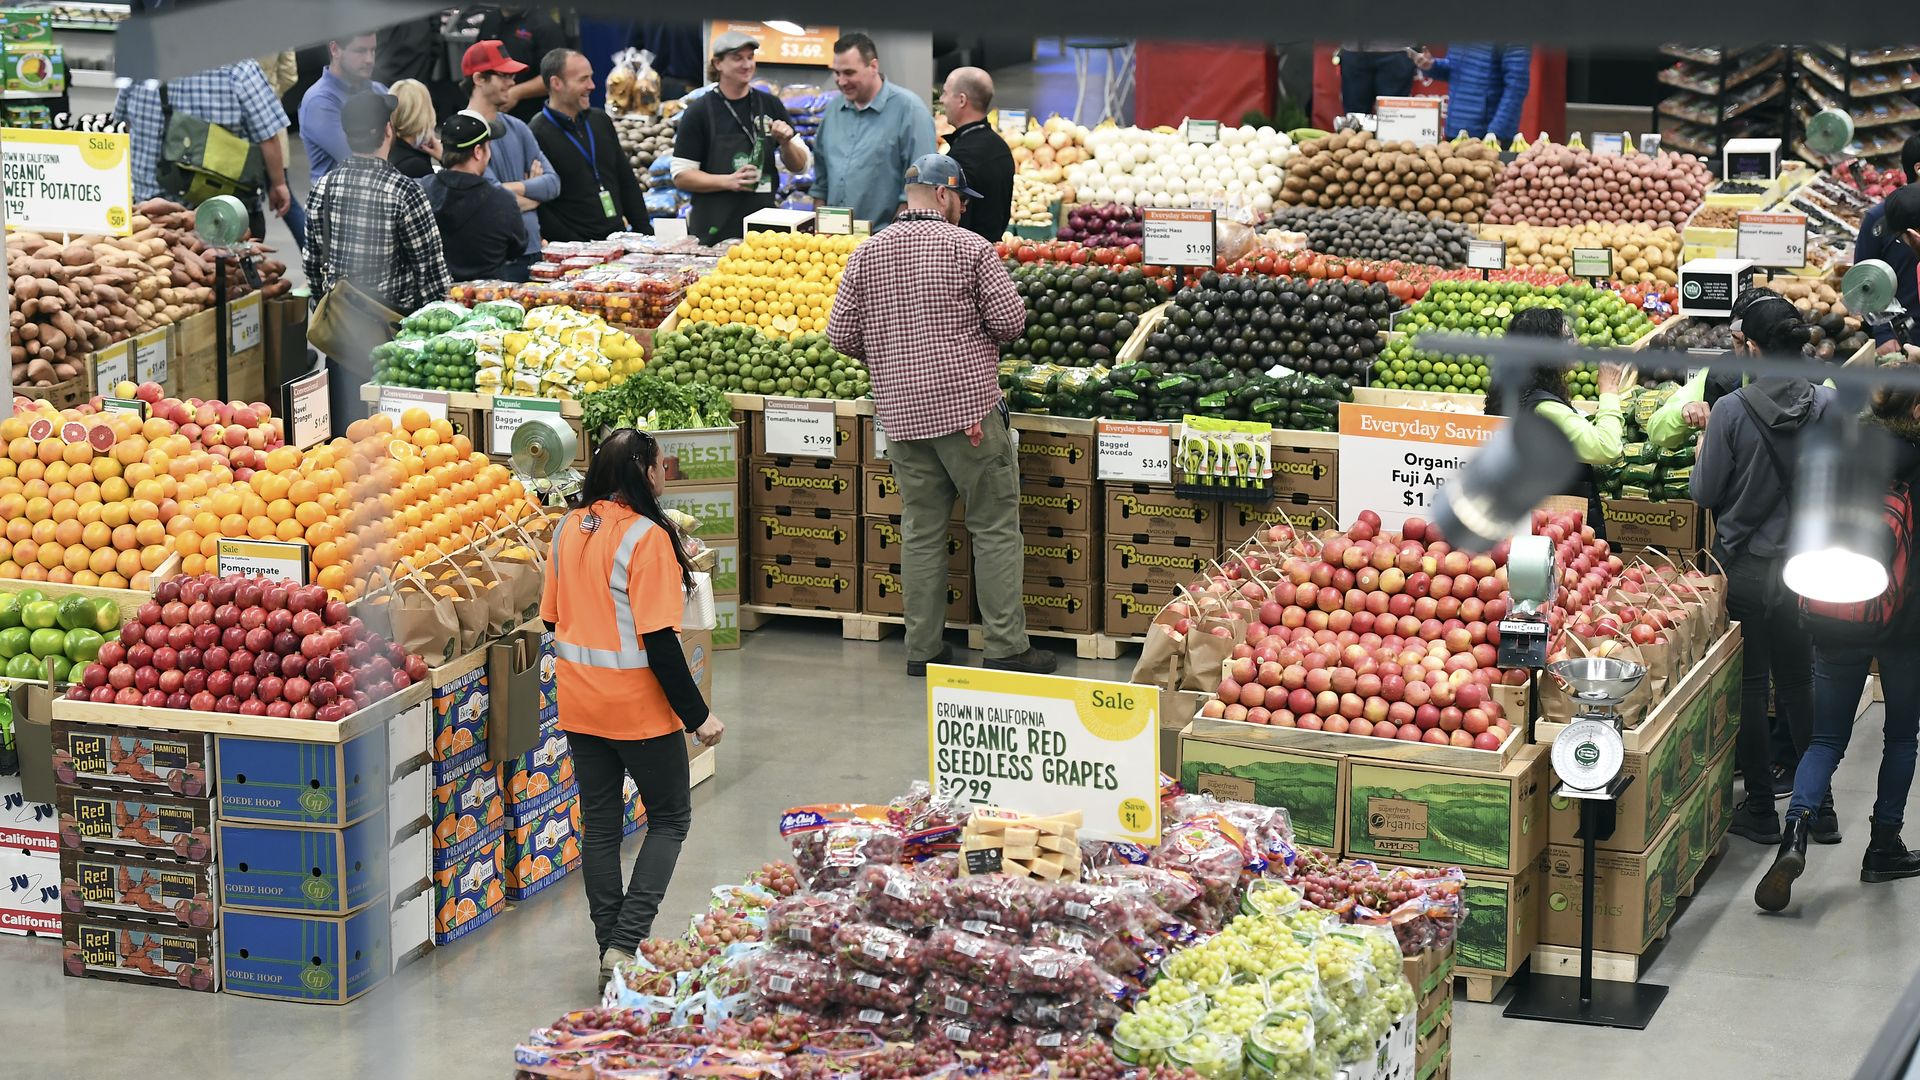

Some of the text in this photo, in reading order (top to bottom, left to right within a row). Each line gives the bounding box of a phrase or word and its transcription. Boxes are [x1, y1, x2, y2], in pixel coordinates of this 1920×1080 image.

[89, 138, 115, 150] Sale
[3, 152, 60, 163] OWN IN CALIFORNIA
[4, 163, 45, 180] RGANIC
[4, 181, 102, 201] WEET POTATOES
[1151, 212, 1204, 221] Everyday Savings
[1186, 244, 1211, 253] $1.99
[1786, 245, 1802, 254] 59¢
[152, 359, 165, 374] $1.49
[293, 381, 319, 397] Conventional
[384, 389, 424, 399] Conventional
[294, 404, 307, 415] Navel
[381, 404, 401, 413] Limes
[497, 400, 521, 408] Organic
[767, 401, 809, 410] Conventional
[294, 413, 313, 425] Oranges
[314, 413, 329, 429] $1.49
[495, 416, 523, 425] Bagged
[1105, 423, 1163, 435] Everyday Savings
[1360, 414, 1495, 442] Everyday Savin
[664, 442, 695, 453] YETI'S
[803, 435, 832, 445] $1.99
[1100, 440, 1129, 449] Bagged
[677, 446, 731, 464] BEST
[1018, 442, 1083, 459] avocado
[1100, 449, 1133, 457] Avocado
[1142, 459, 1168, 469] $3.49
[1271, 459, 1328, 476] vocado
[1404, 453, 1467, 471] Organic
[760, 467, 848, 492] Bravocado
[1392, 469, 1419, 487] Fuji
[1019, 493, 1081, 511] avocado
[1114, 494, 1209, 520] Bravocado
[760, 516, 847, 541] Bravocado
[1146, 528, 1178, 536] AVOCADOS
[222, 545, 239, 553] Sale
[1113, 544, 1208, 570] Bravocado
[221, 563, 280, 575] Pomegranate
[761, 565, 848, 590] Bravocado
[1021, 594, 1082, 611] avocado
[442, 679, 462, 696] PREMIUM
[1092, 690, 1135, 711] Sale
[937, 702, 1046, 727] GROWN IN CALIFORNIA
[937, 720, 1066, 757] ORGANIC RED
[76, 738, 99, 755] Red
[154, 744, 186, 754] HAMILTON
[73, 755, 105, 771] Robin
[937, 748, 1119, 791] SEEDLESS GRAPES
[443, 769, 464, 784] PREMIUM
[1208, 781, 1239, 790] superfresh
[1215, 789, 1238, 797] growers
[222, 795, 281, 808] GOEDE HOOP
[516, 784, 563, 814] PREMIUM CALIFORNIA
[1124, 802, 1145, 811] Save
[81, 802, 105, 819] Red
[160, 809, 191, 819] HAMILTON
[1378, 806, 1411, 814] superfresh
[78, 819, 111, 835] Robin
[0, 833, 58, 849] California
[1379, 841, 1414, 851] APPLES
[84, 868, 108, 884] Red
[162, 874, 194, 885] HAMILTON
[523, 866, 567, 898] PREMIUM CALIFORNIA
[80, 884, 114, 900] Robin
[225, 883, 284, 896] GOEDE HOOP
[1, 914, 62, 930] California
[446, 908, 492, 942] PREMIUM CALIFORNIA
[86, 931, 109, 947] Red
[164, 939, 195, 949] HAMILTON
[82, 948, 116, 964] Robin
[226, 970, 283, 983] GOEDE HOOP
